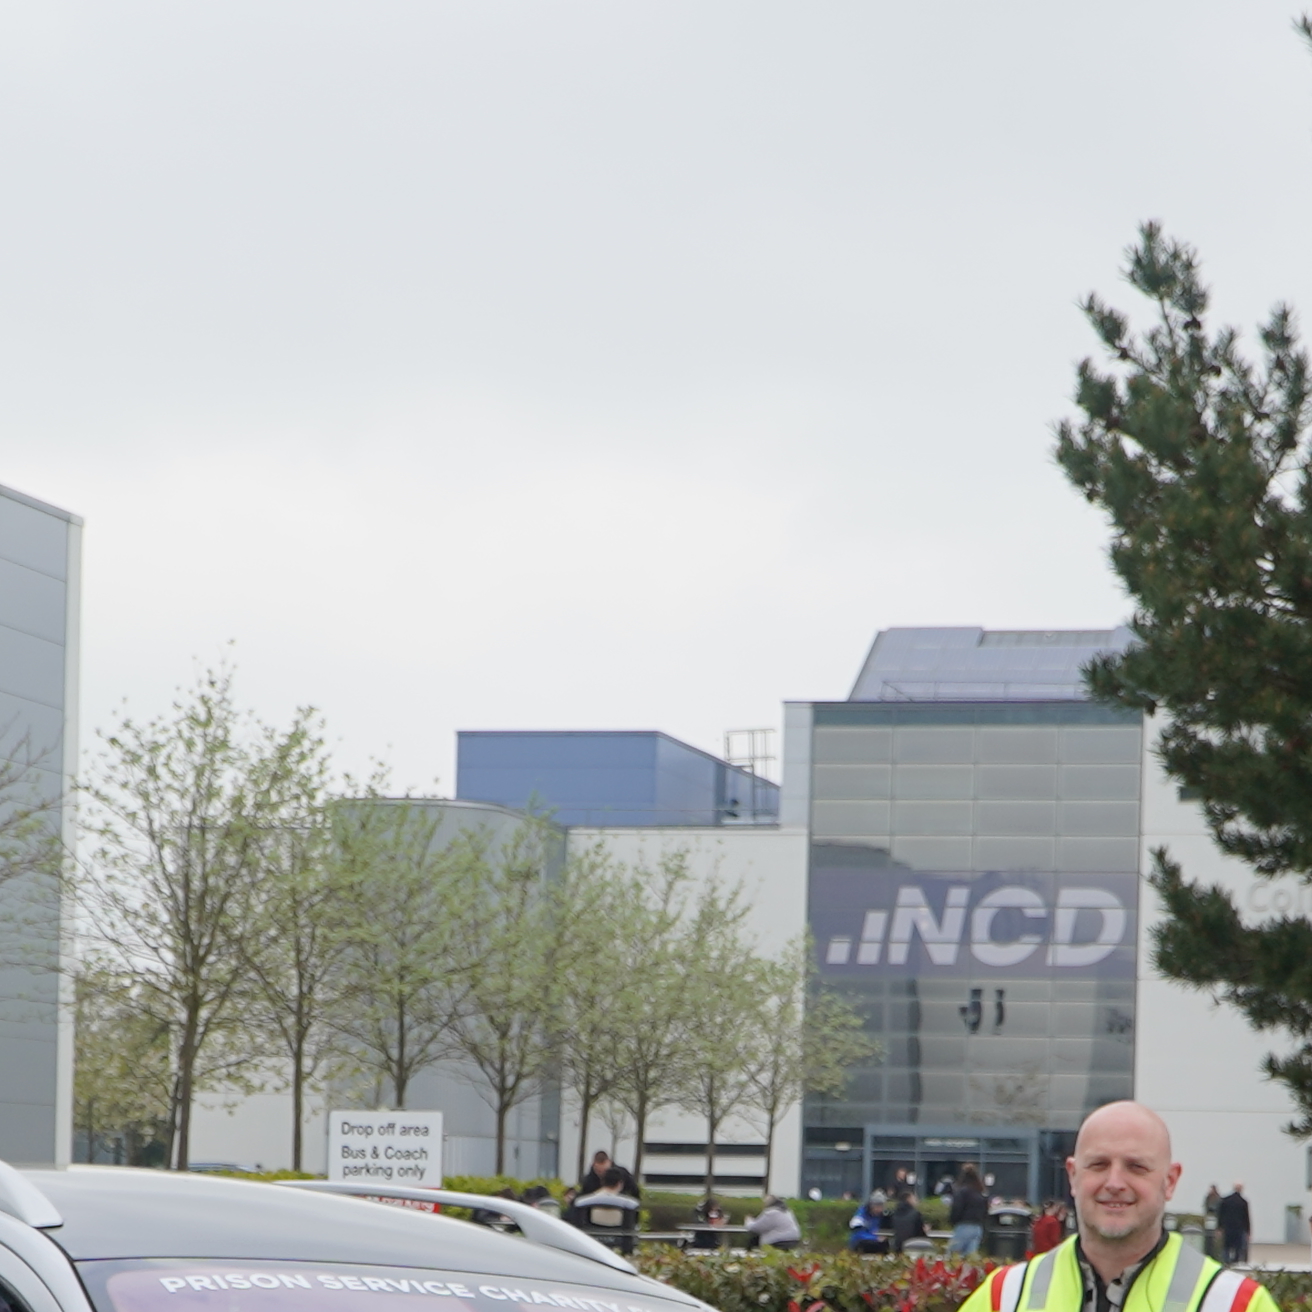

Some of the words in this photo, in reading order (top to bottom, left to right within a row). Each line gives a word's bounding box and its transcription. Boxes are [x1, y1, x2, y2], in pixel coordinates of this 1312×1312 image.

[341, 1121, 374, 1138] Drop
[378, 1122, 396, 1136] off
[399, 1125, 430, 1136] area
[341, 1145, 366, 1159] Bus
[370, 1146, 380, 1159] &
[384, 1146, 428, 1160] Coach
[343, 1164, 393, 1180] parking
[397, 1165, 426, 1180] only
[159, 1273, 312, 1293] PRISON
[316, 1275, 475, 1299] SERVICE
